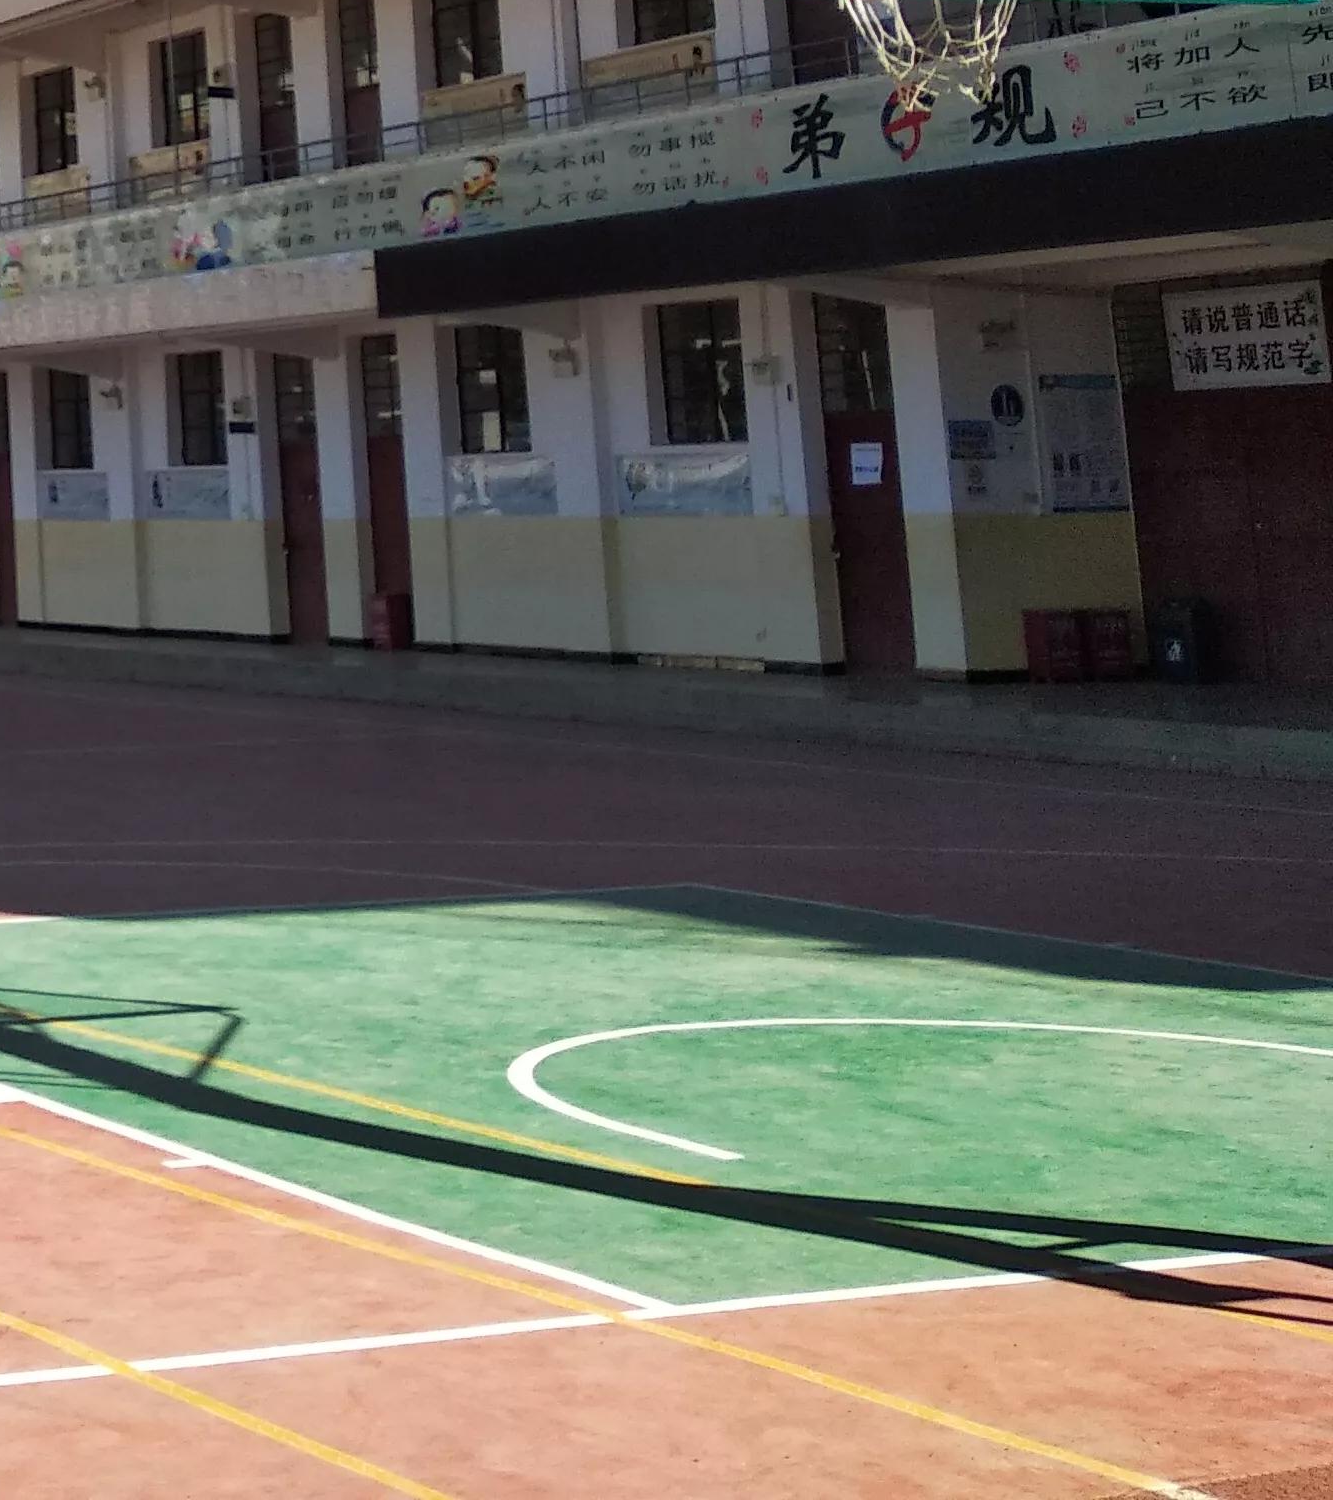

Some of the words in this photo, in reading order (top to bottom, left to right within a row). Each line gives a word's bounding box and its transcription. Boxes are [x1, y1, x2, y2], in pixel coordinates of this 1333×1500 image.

[1126, 36, 1260, 73] 将加人
[1182, 300, 1306, 335] 请说普通话
[1185, 340, 1312, 375] 请写规范字
